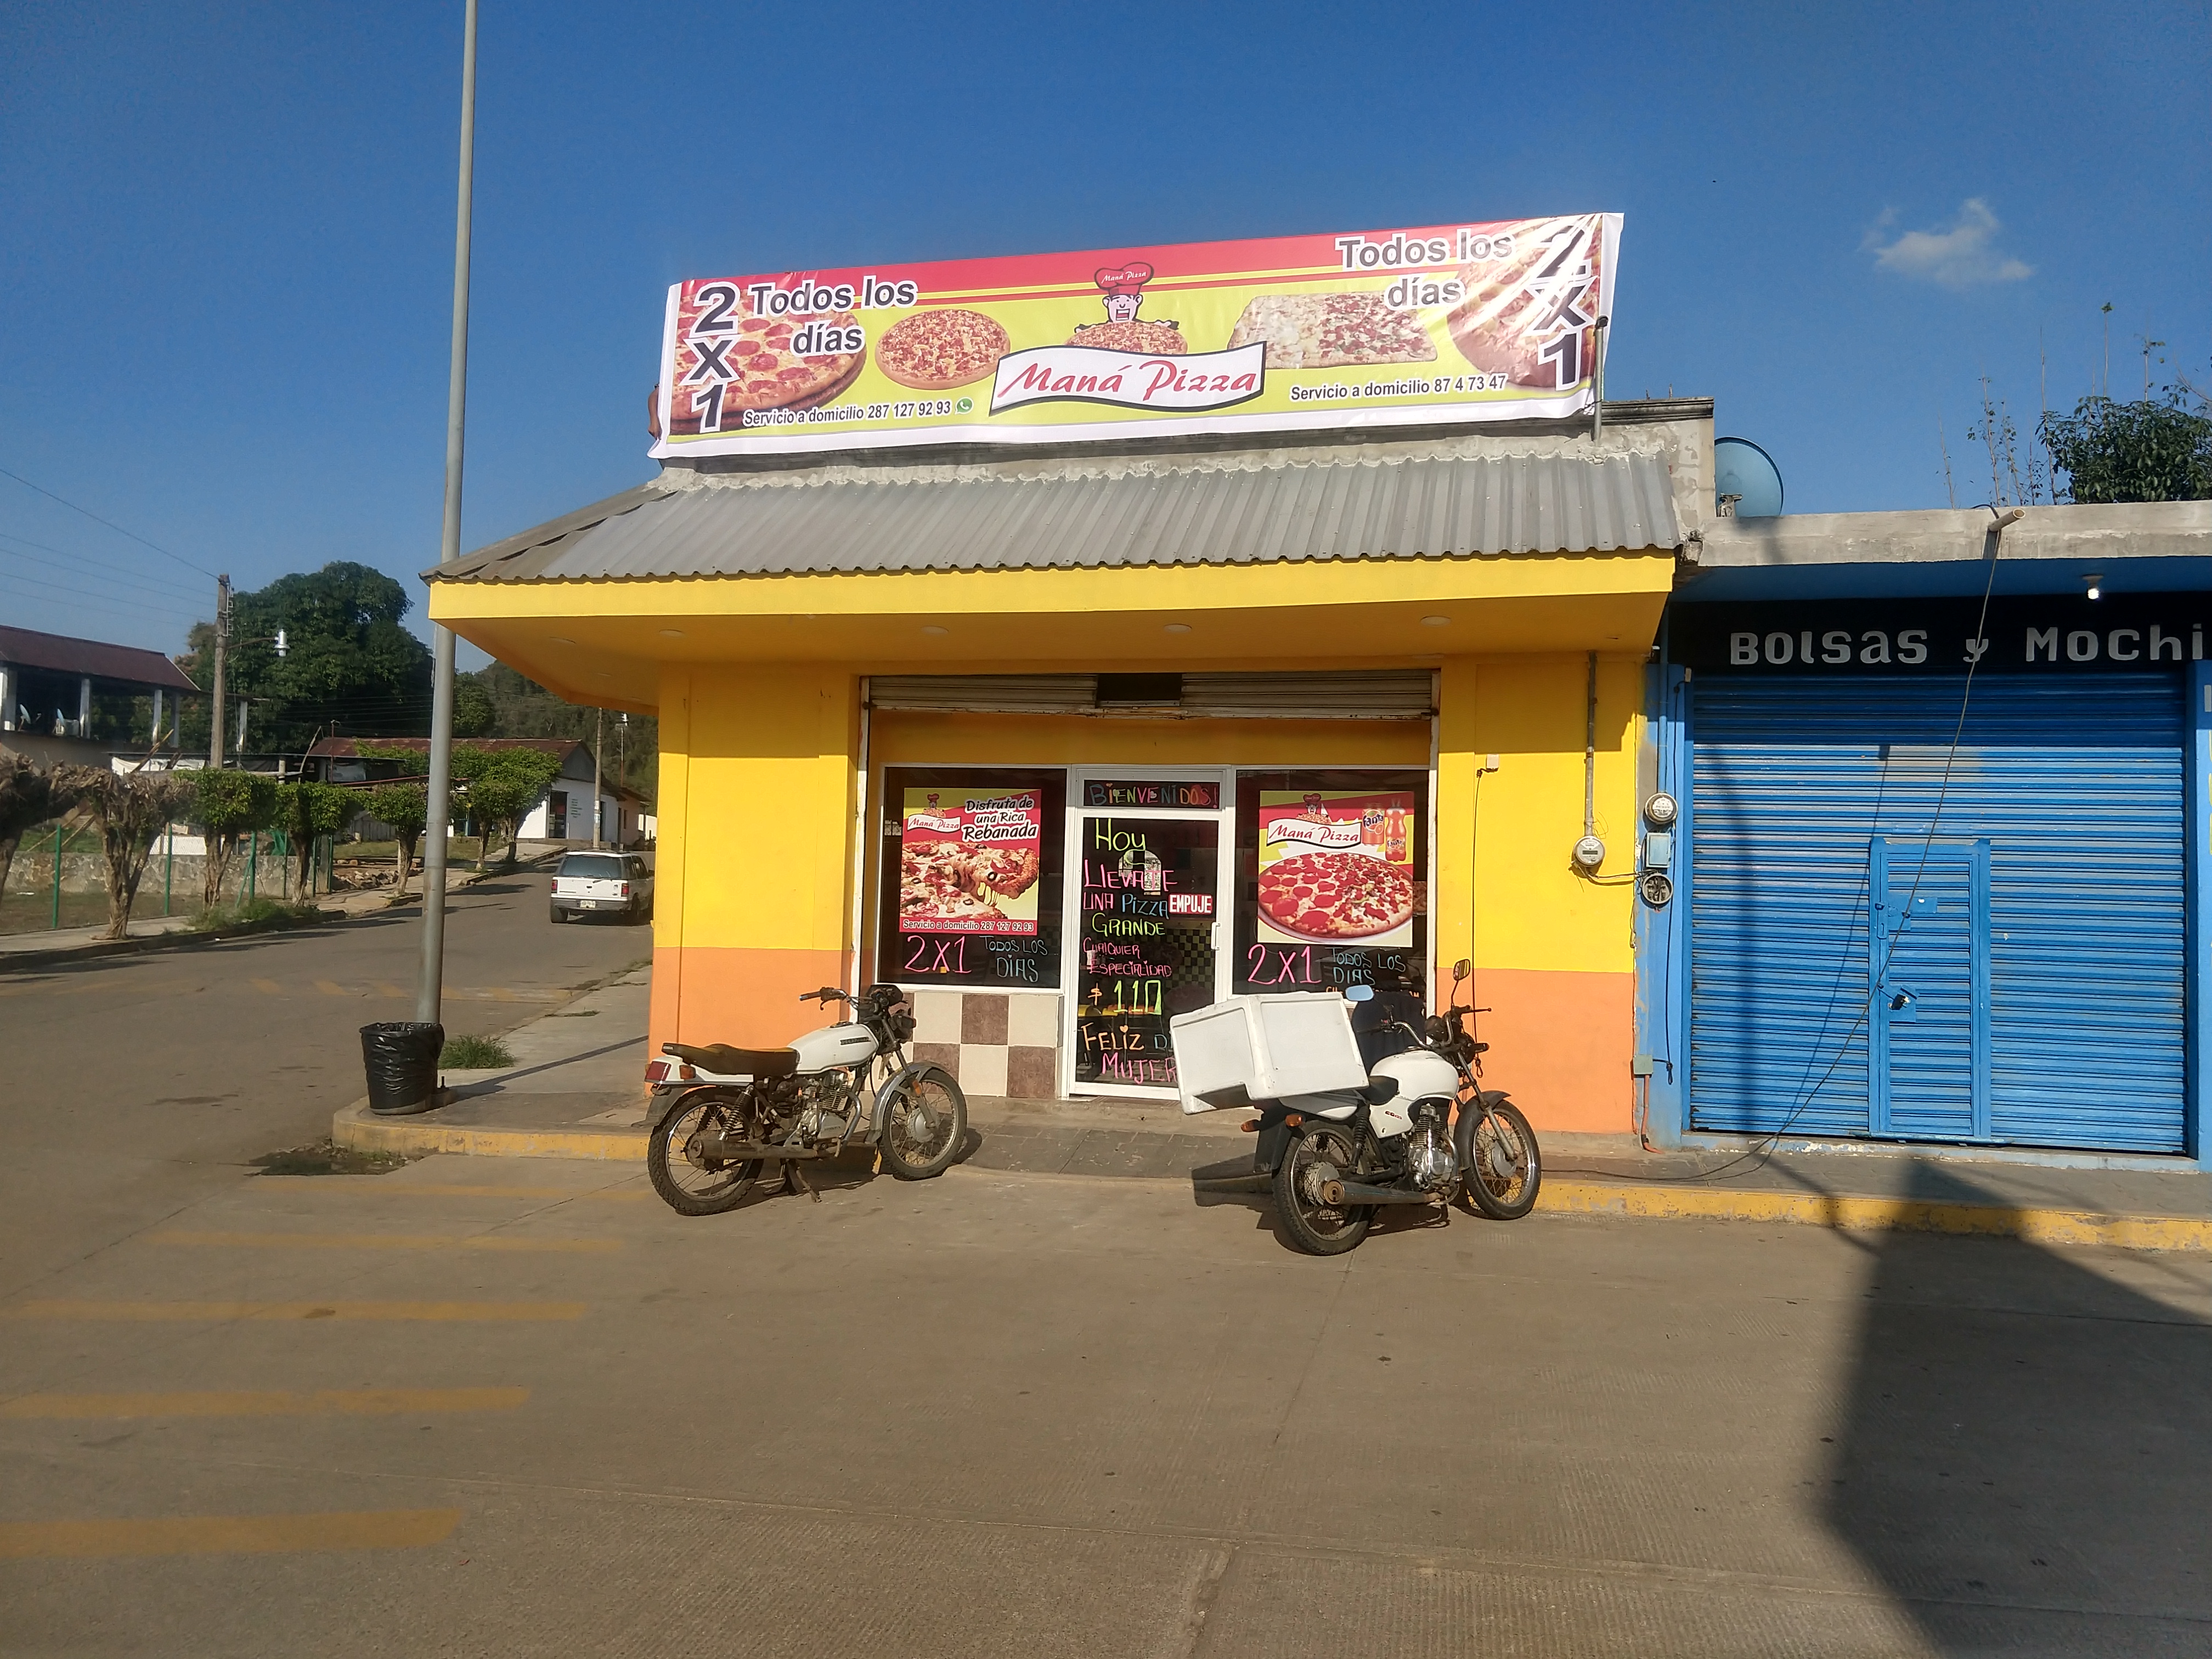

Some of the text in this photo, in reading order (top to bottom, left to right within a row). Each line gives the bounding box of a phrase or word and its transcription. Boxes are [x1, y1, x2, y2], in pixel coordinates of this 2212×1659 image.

[1340, 231, 1512, 268] Todos los
[1101, 271, 1147, 284] Maná Pizza
[751, 278, 916, 314] Todos los
[1387, 277, 1461, 307] días
[793, 323, 863, 353] días
[997, 360, 1256, 401] Maná Pizza
[1291, 375, 1505, 400] Servicio a domicilio 87 4 73 47
[744, 401, 951, 426] Servicio a domicilio 287 127 92 93
[1963, 638, 1989, 663] y
[966, 797, 1032, 811] Disfruta de
[909, 818, 959, 829] Maná Pizza
[1000, 812, 1024, 822] Rica
[963, 822, 1037, 840] Rebanada
[1269, 825, 1358, 843] Maná Pizza
[1083, 892, 1114, 911] UNA
[1170, 895, 1212, 913] EMPUJE
[904, 920, 934, 928] Servicio
[944, 921, 979, 929] domicilio
[981, 922, 994, 930] 287
[997, 922, 1010, 930] 127
[1024, 923, 1033, 931] 93
[1092, 912, 1165, 937] GRANDE
[979, 935, 1020, 952] TODOS
[1023, 939, 1048, 955] LOS
[1325, 947, 1372, 968] TODOS
[1378, 953, 1406, 972] LOS
[1333, 967, 1375, 985] DIAS
[1102, 1052, 1177, 1084] MUJER
